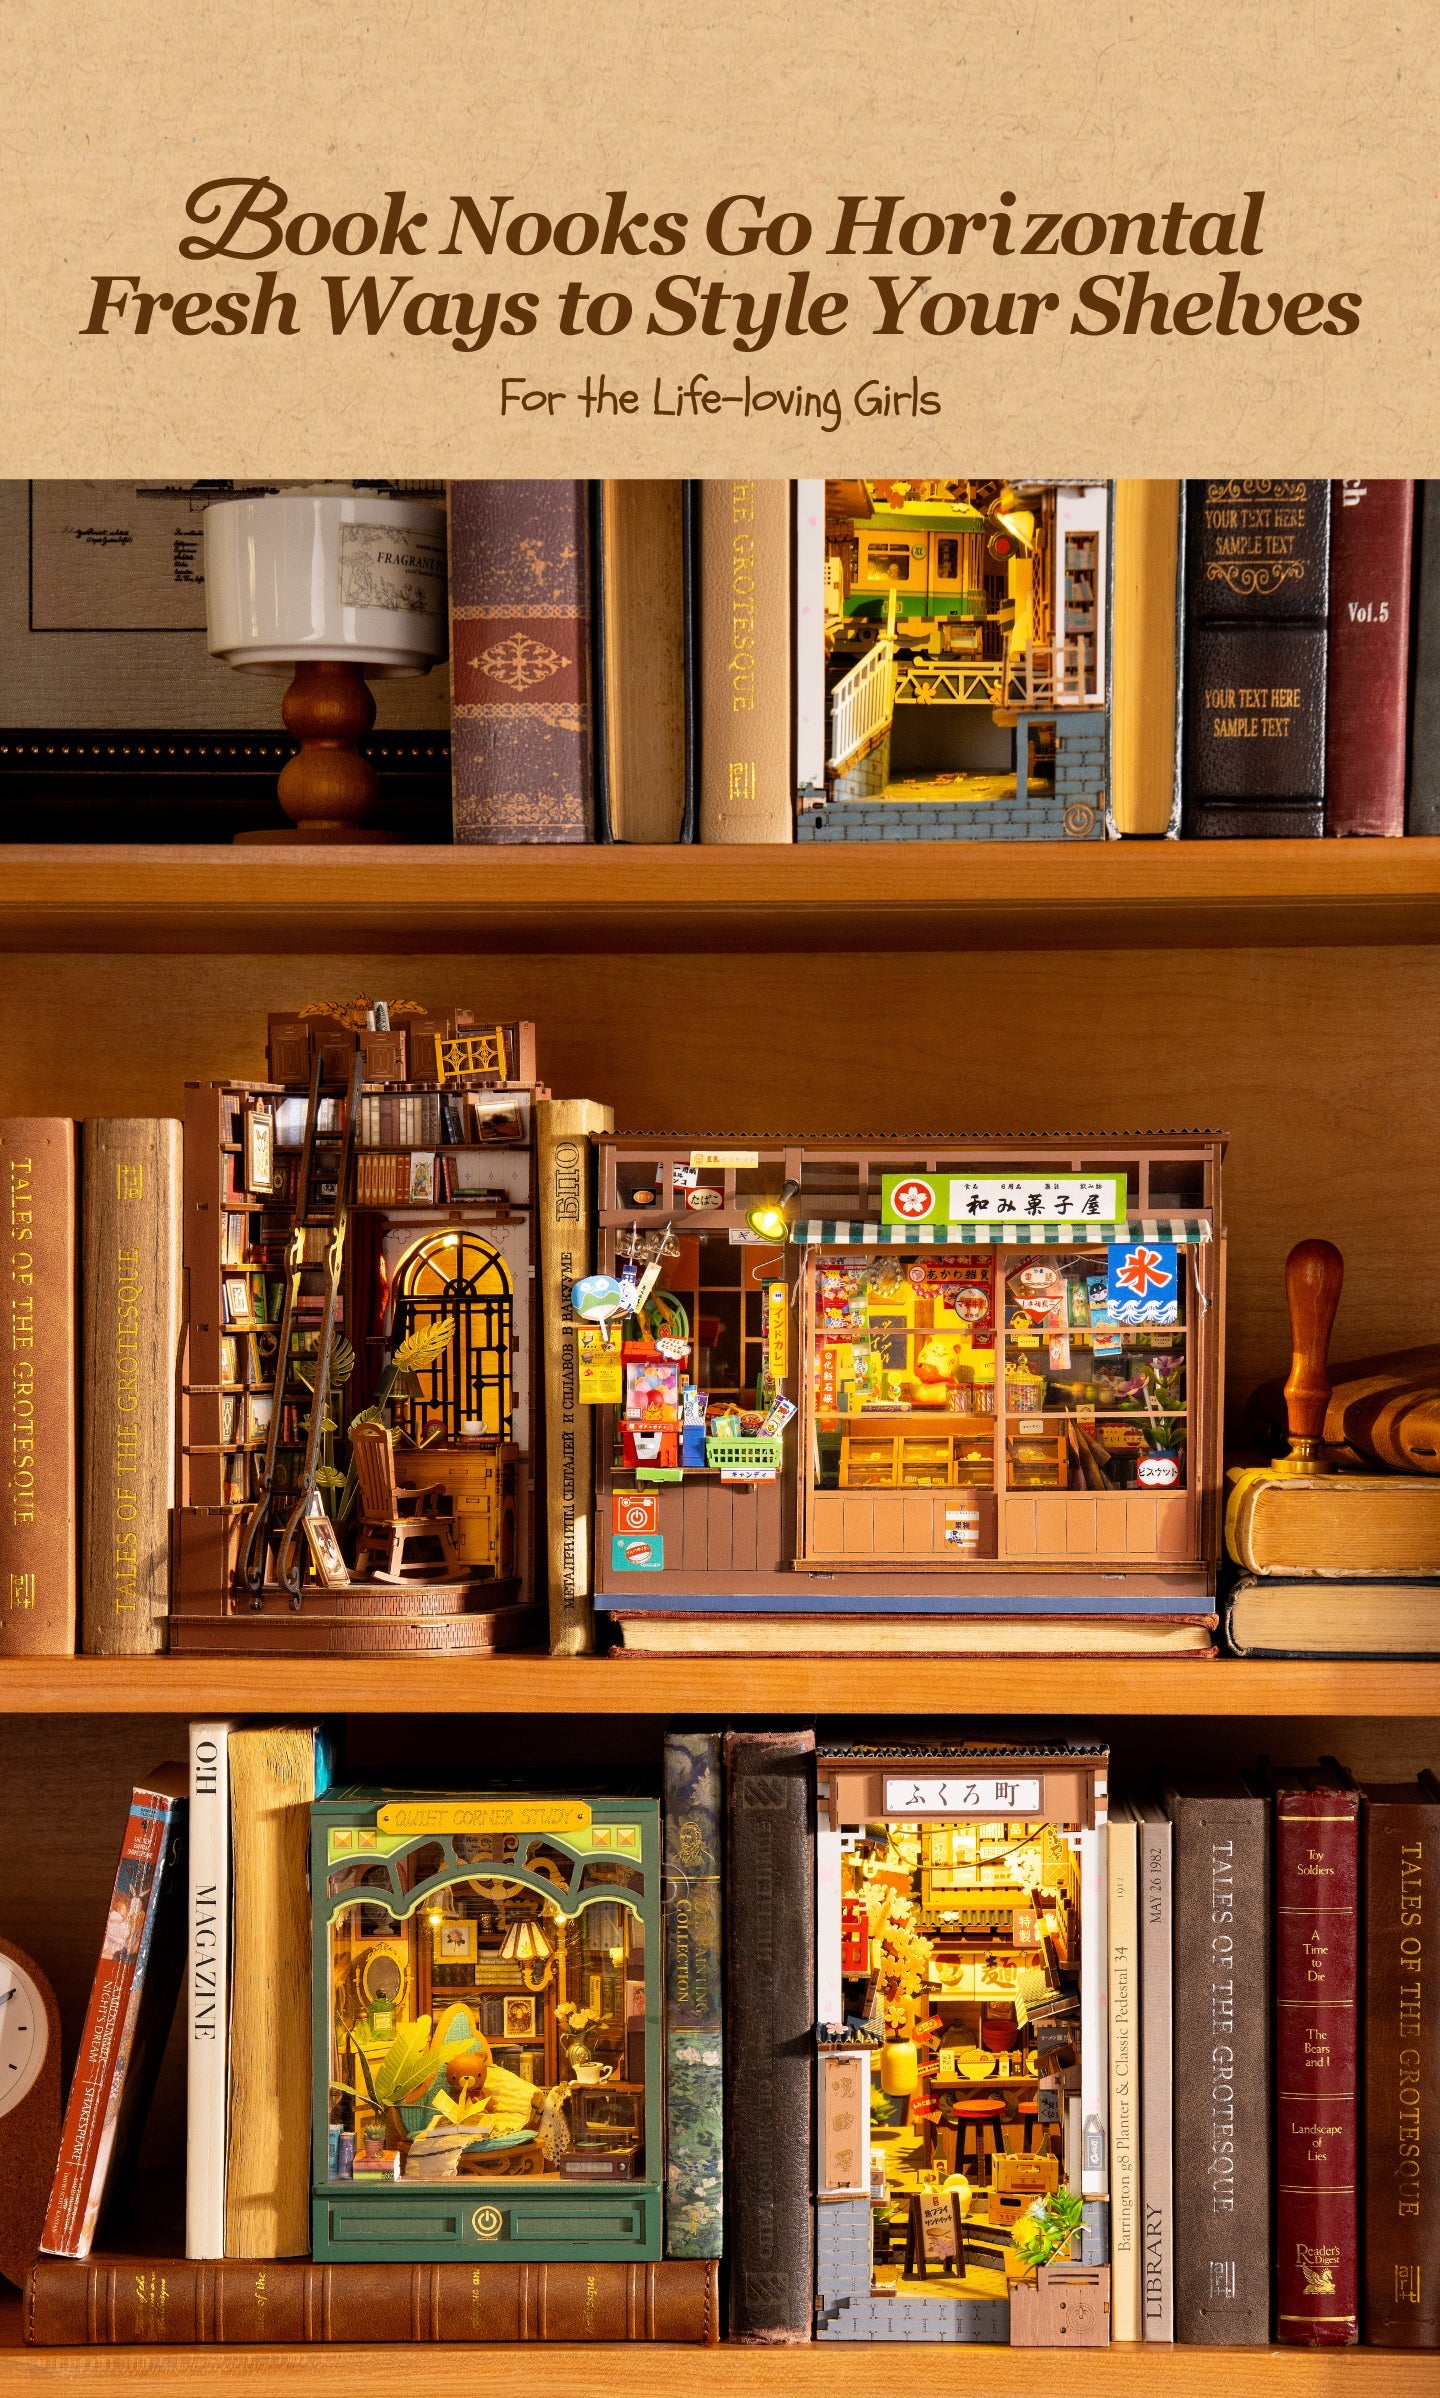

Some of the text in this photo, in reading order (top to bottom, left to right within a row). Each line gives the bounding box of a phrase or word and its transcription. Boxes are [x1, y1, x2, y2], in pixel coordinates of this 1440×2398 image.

[1205, 508, 1306, 529] YOUR TEXT HERE
[1215, 535, 1296, 556] SAMPLE TEXT
[728, 533, 756, 714] GROTESQUE
[1348, 602, 1389, 623] Vol.5
[1205, 688, 1301, 709] YOUR TEXT HERE
[1213, 717, 1291, 738] SAMPLE TEXT
[554, 1141, 581, 1223] БПО
[966, 1192, 1101, 1217] 和み菓子屋
[1116, 1246, 1173, 1298] 氷
[561, 1251, 574, 1321] ВАКУУМЕ
[8, 1157, 35, 1526] TALES OF THE GROTESQUE
[773, 1308, 784, 1367] インドカレー
[562, 1342, 574, 1411] СПЛАВОВ
[115, 1247, 143, 1615] TALES OF THE GROTESQUE
[905, 1782, 1020, 1807] ふくろ町
[394, 1806, 573, 1828] QUIET CORNER STUDY
[1306, 1849, 1324, 1862] Toy
[1297, 1863, 1335, 1876] Soldiers
[1150, 1848, 1162, 1924] MAY 26 1982
[1018, 1916, 1032, 1944] 特製
[1311, 1930, 1321, 1941] A
[195, 1883, 218, 2040] MAGAZINE
[1114, 1946, 1128, 1964] 34
[1303, 1943, 1329, 1956] Time
[694, 1935, 711, 2014] PAINTING
[1311, 1958, 1322, 1968] to
[1307, 1970, 1326, 1982] Die
[1114, 1968, 1129, 2024] Pedestal
[88, 1980, 111, 2064] NIGHT'S DREAM
[1207, 1840, 1234, 2213] TALES OF THE GROTESQUE
[1305, 2028, 1327, 2041] The
[1394, 1841, 1423, 2217] TALES OF THE GROTESQUE
[1115, 2027, 1129, 2077] Classic
[1304, 2042, 1331, 2054] Bears
[1304, 2056, 1331, 2067] and I
[1116, 2082, 1129, 2096] &
[71, 2086, 95, 2161] SHAKESPEARE
[1116, 2100, 1130, 2151] Planter
[1292, 2122, 1343, 2137] Landscape
[1312, 2137, 1323, 2148] of
[1308, 2150, 1328, 2161] Lies
[1117, 2176, 1134, 2252] Barrington
[1146, 2204, 1163, 2319] LIBRARY
[1295, 2243, 1341, 2265] Reader's
[1314, 2255, 1340, 2266] Digest
